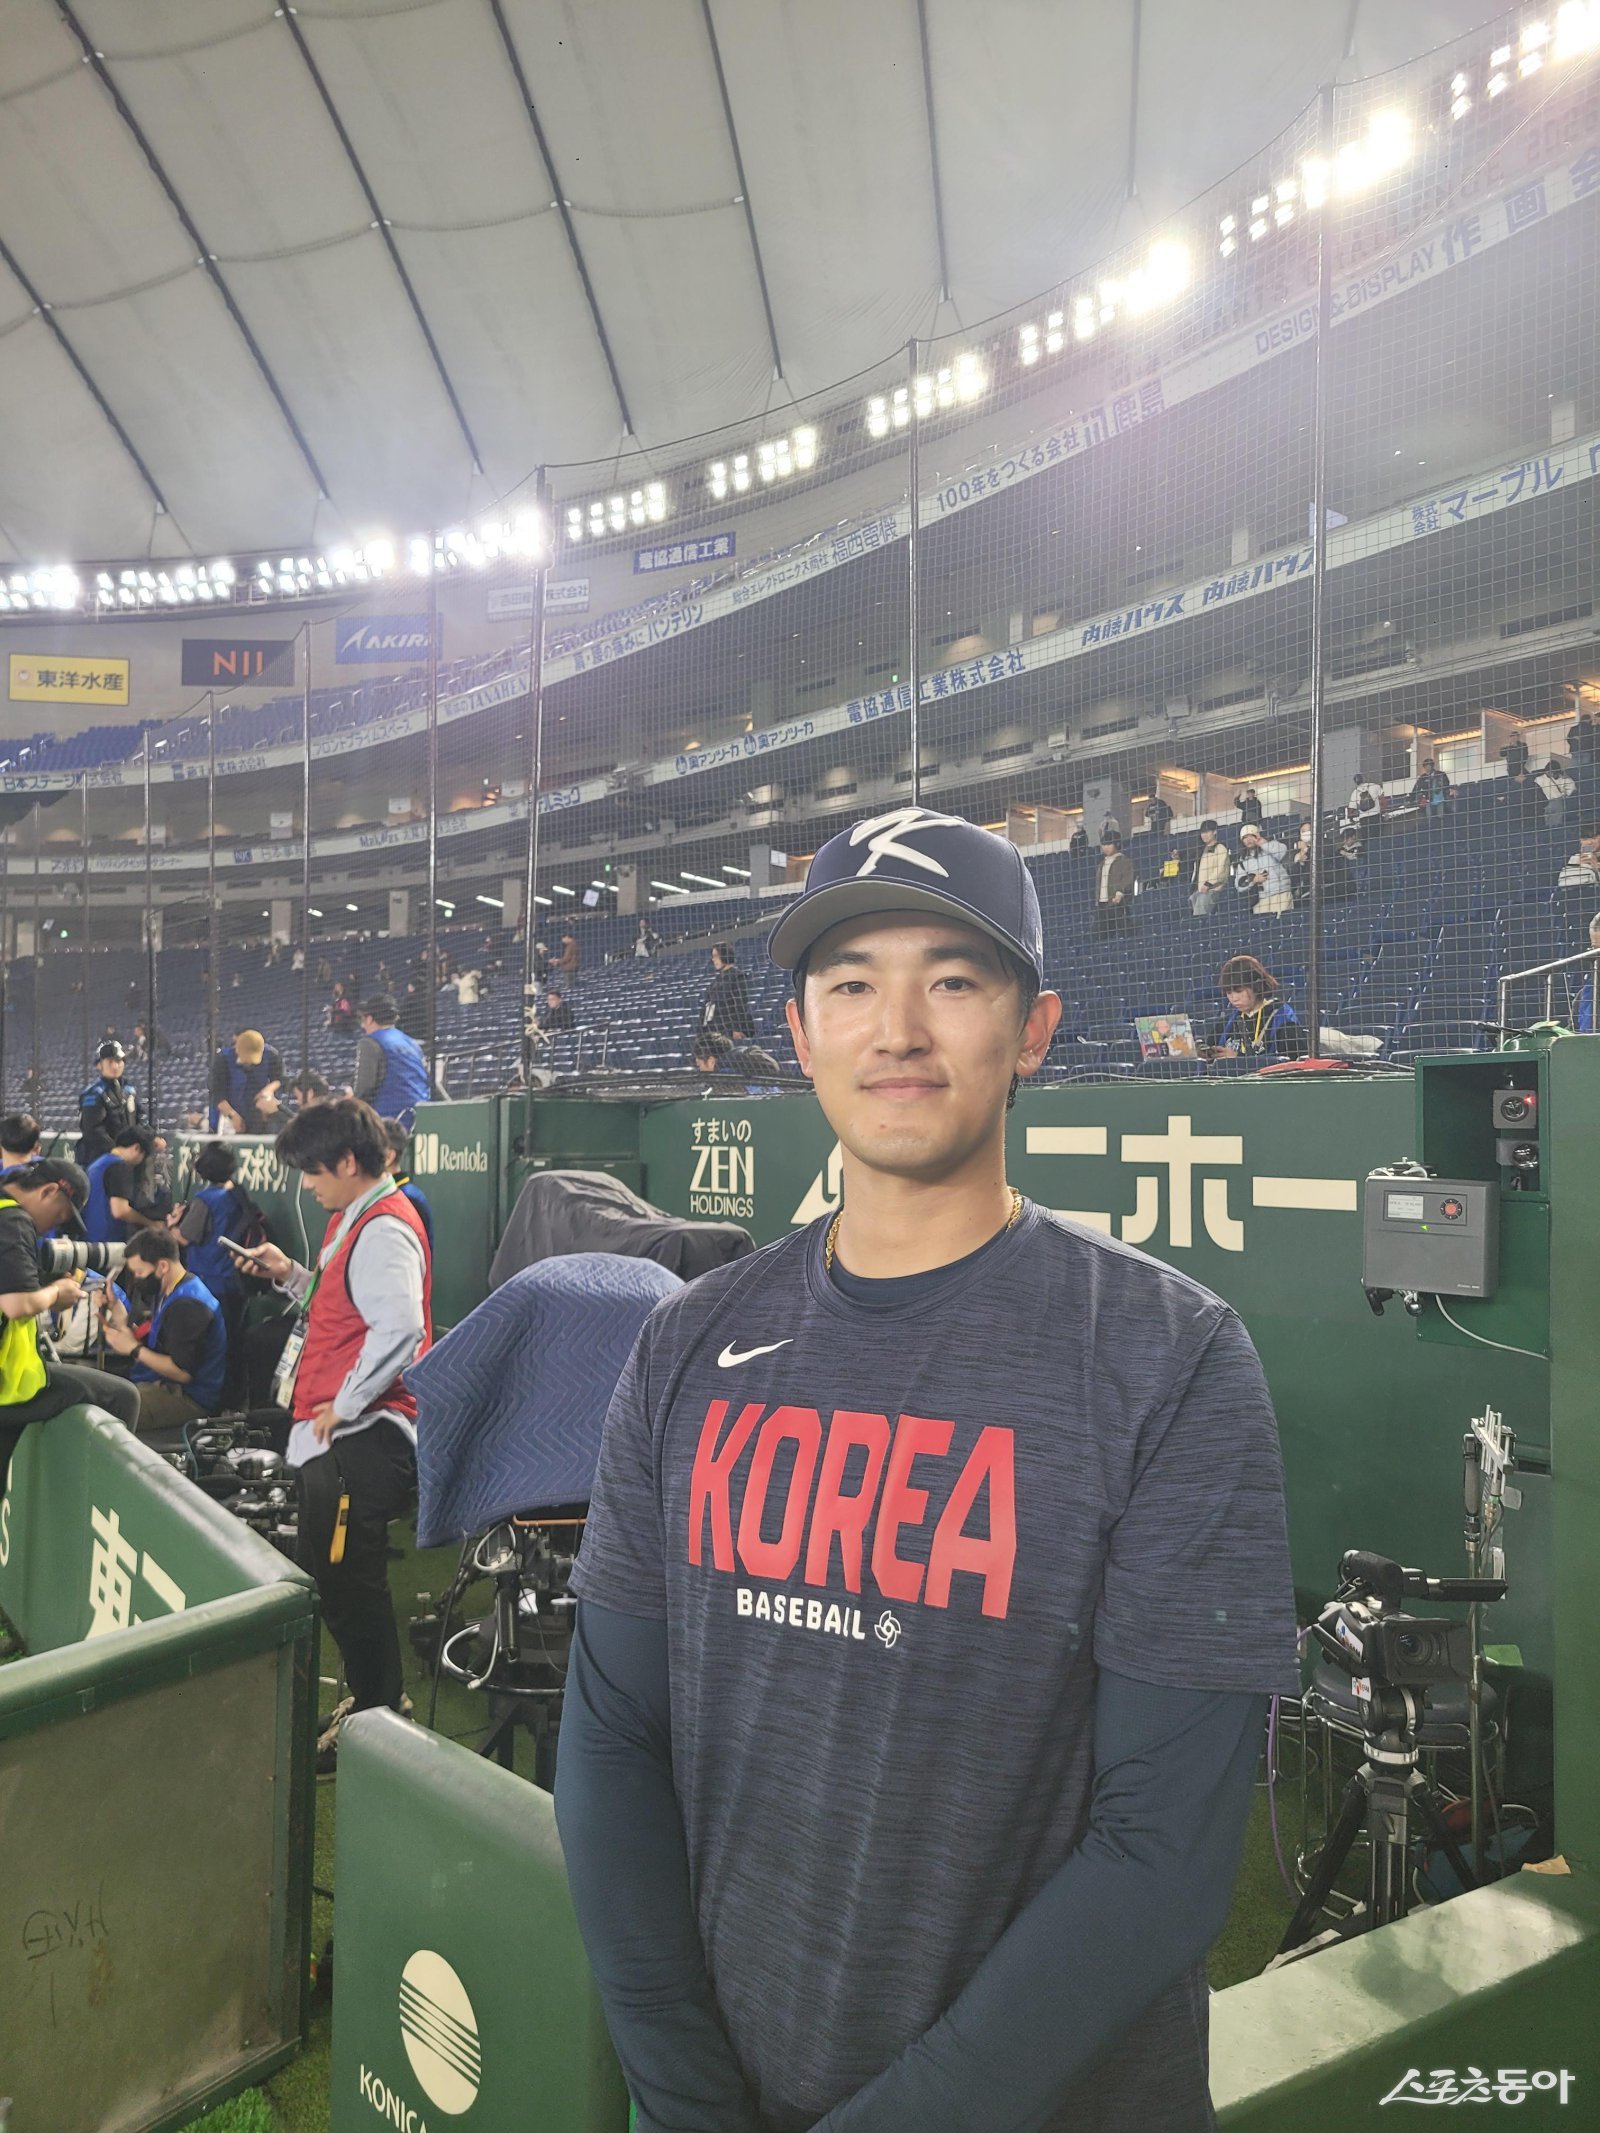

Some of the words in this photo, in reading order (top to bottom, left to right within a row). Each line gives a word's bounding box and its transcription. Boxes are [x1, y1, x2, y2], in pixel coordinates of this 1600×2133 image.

[937, 427, 1080, 512] 100年をつくる会社
[1440, 456, 1564, 520] マーブル
[639, 537, 729, 570] 電協通信工業
[648, 603, 703, 641] バンテリン
[1082, 592, 1185, 646] 内藤ハウス
[37, 670, 124, 691] 東洋水産
[847, 649, 1025, 725] 電協通信工業株式会社
[757, 721, 814, 750] 奥アンツーカ
[691, 1117, 752, 1143] すまいの
[440, 1141, 488, 1173] Rentola
[689, 1145, 754, 1195] ZEN
[690, 1194, 754, 1218] HOLDINGS
[688, 1399, 1017, 1619] KOREA
[737, 1588, 866, 1640] BASEBALL
